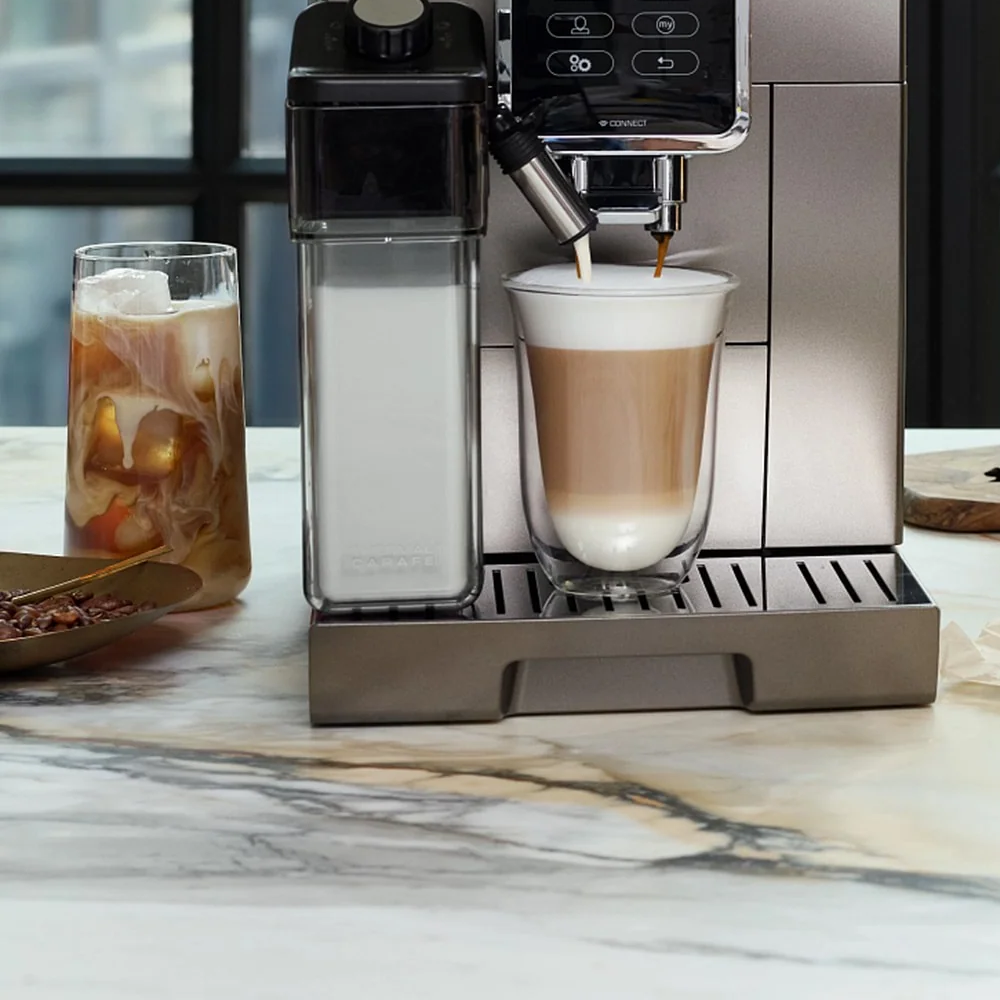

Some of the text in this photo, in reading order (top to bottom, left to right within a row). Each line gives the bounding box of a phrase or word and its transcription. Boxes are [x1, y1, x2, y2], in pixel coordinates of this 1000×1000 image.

[659, 20, 673, 30] my
[609, 119, 647, 127] CONNECT
[352, 556, 434, 569] CARAFE
